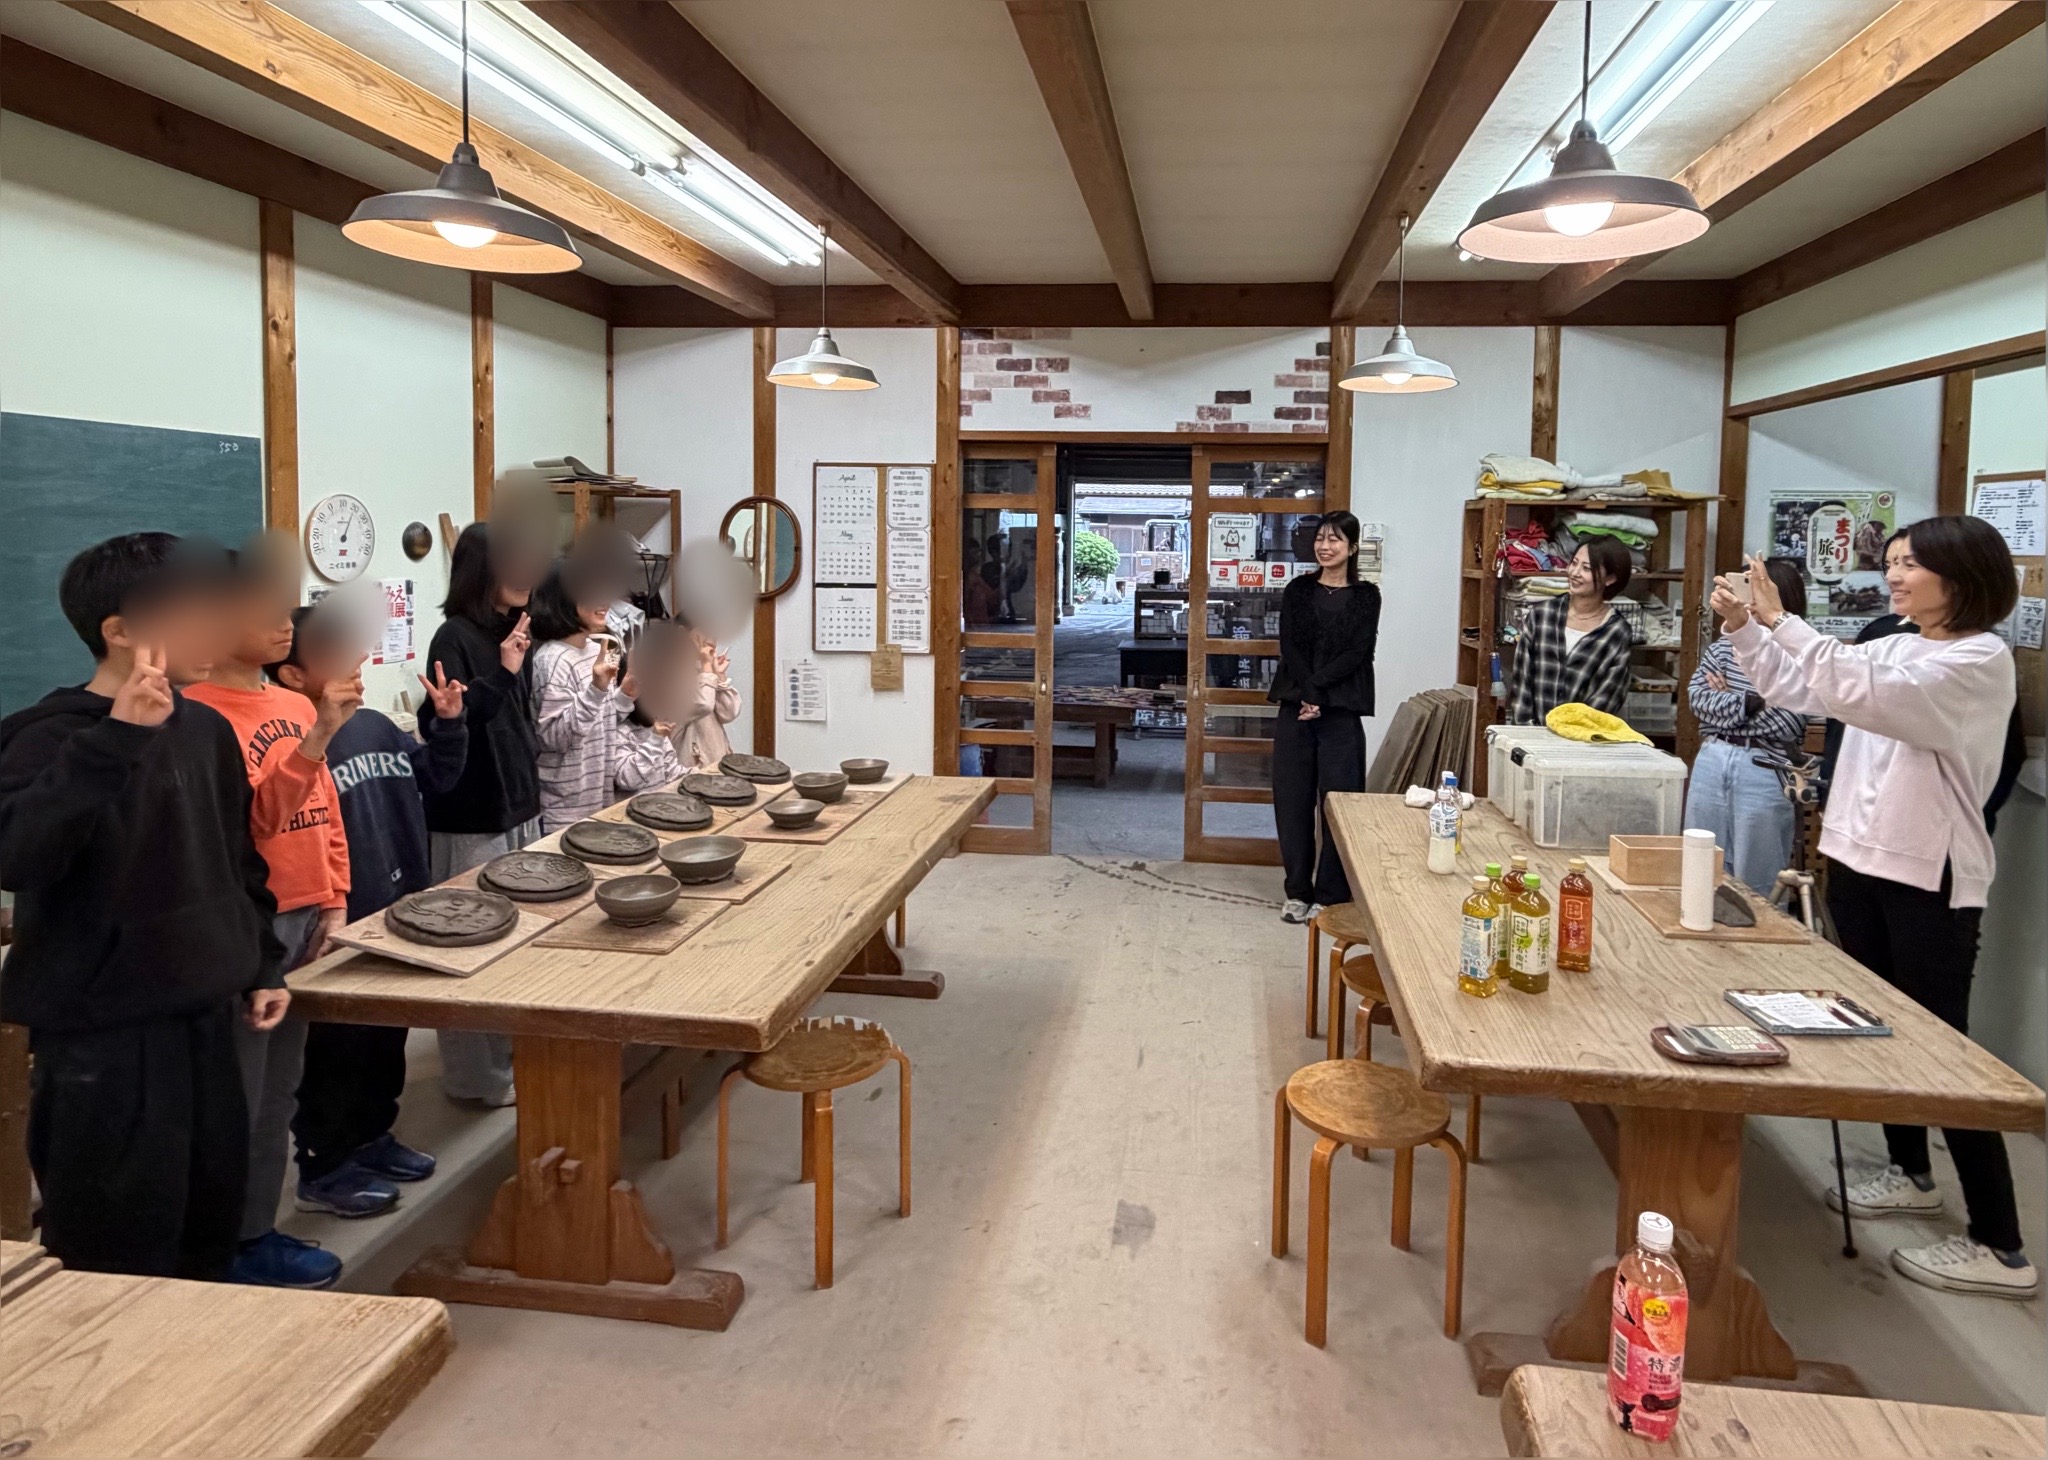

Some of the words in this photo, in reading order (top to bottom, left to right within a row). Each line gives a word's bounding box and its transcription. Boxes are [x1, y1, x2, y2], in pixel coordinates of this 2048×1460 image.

[1818, 538, 1835, 575] 旅する
[1242, 565, 1261, 573] au
